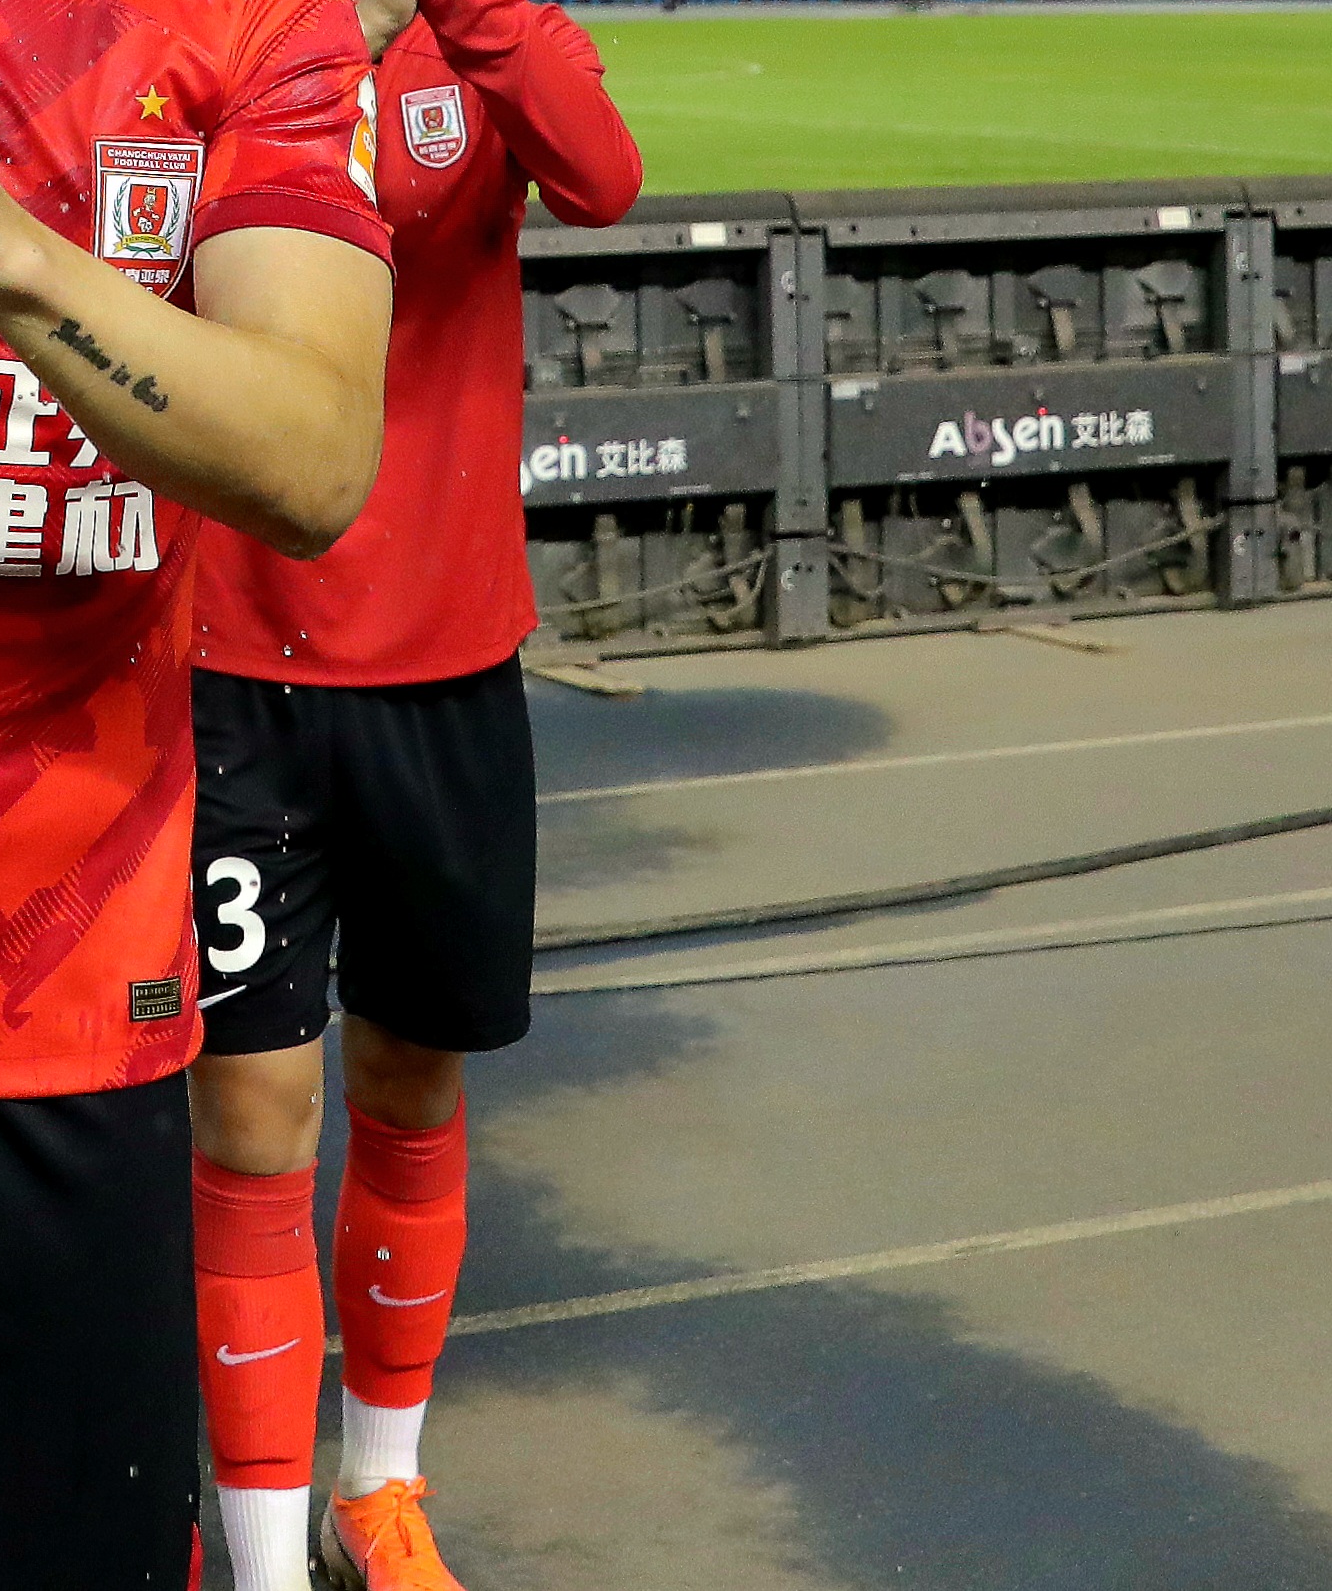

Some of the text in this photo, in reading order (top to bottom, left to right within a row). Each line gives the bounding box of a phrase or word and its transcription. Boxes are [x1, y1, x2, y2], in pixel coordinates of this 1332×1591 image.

[107, 148, 191, 162] CHANGCHUN YATAI
[114, 158, 186, 170] FOOTBALL CLUB
[119, 267, 170, 283] 春亚泰
[927, 407, 1154, 468] Absen 艾比森
[595, 437, 687, 479] 艾比森
[192, 857, 268, 974] 3
